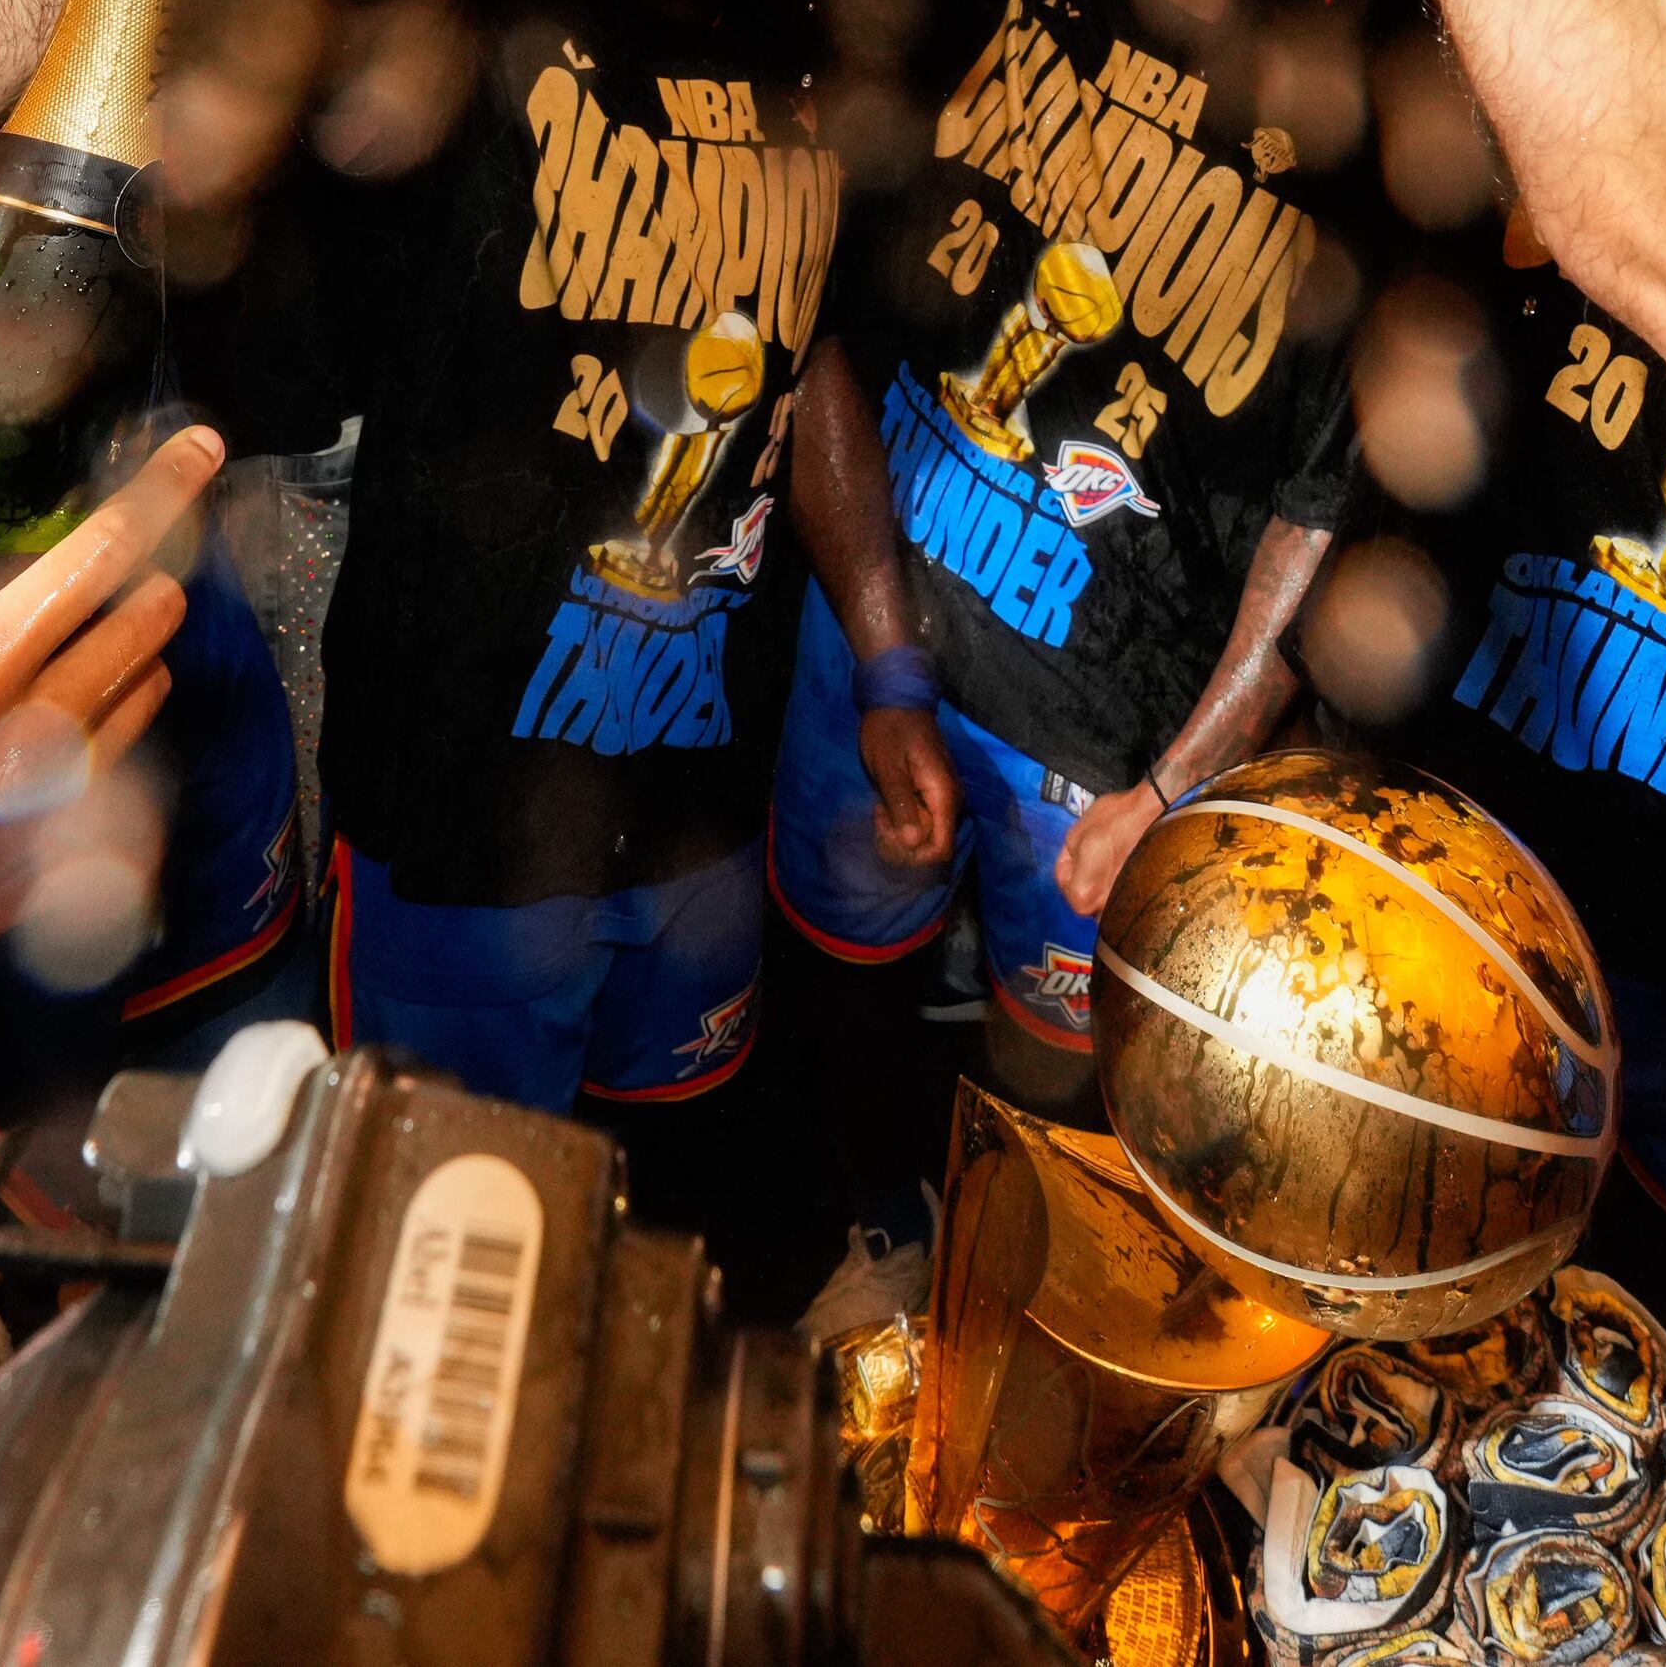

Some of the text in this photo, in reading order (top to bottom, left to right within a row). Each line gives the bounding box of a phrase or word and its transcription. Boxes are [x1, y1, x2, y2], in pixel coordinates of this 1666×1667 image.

[657, 77, 766, 141] NBA
[1094, 39, 1209, 141] NBA
[927, 198, 1169, 460] 20 25
[552, 354, 629, 462] 20
[1544, 322, 1649, 451] 20
[1044, 462, 1124, 493] OKC
[1040, 969, 1092, 995] OK
